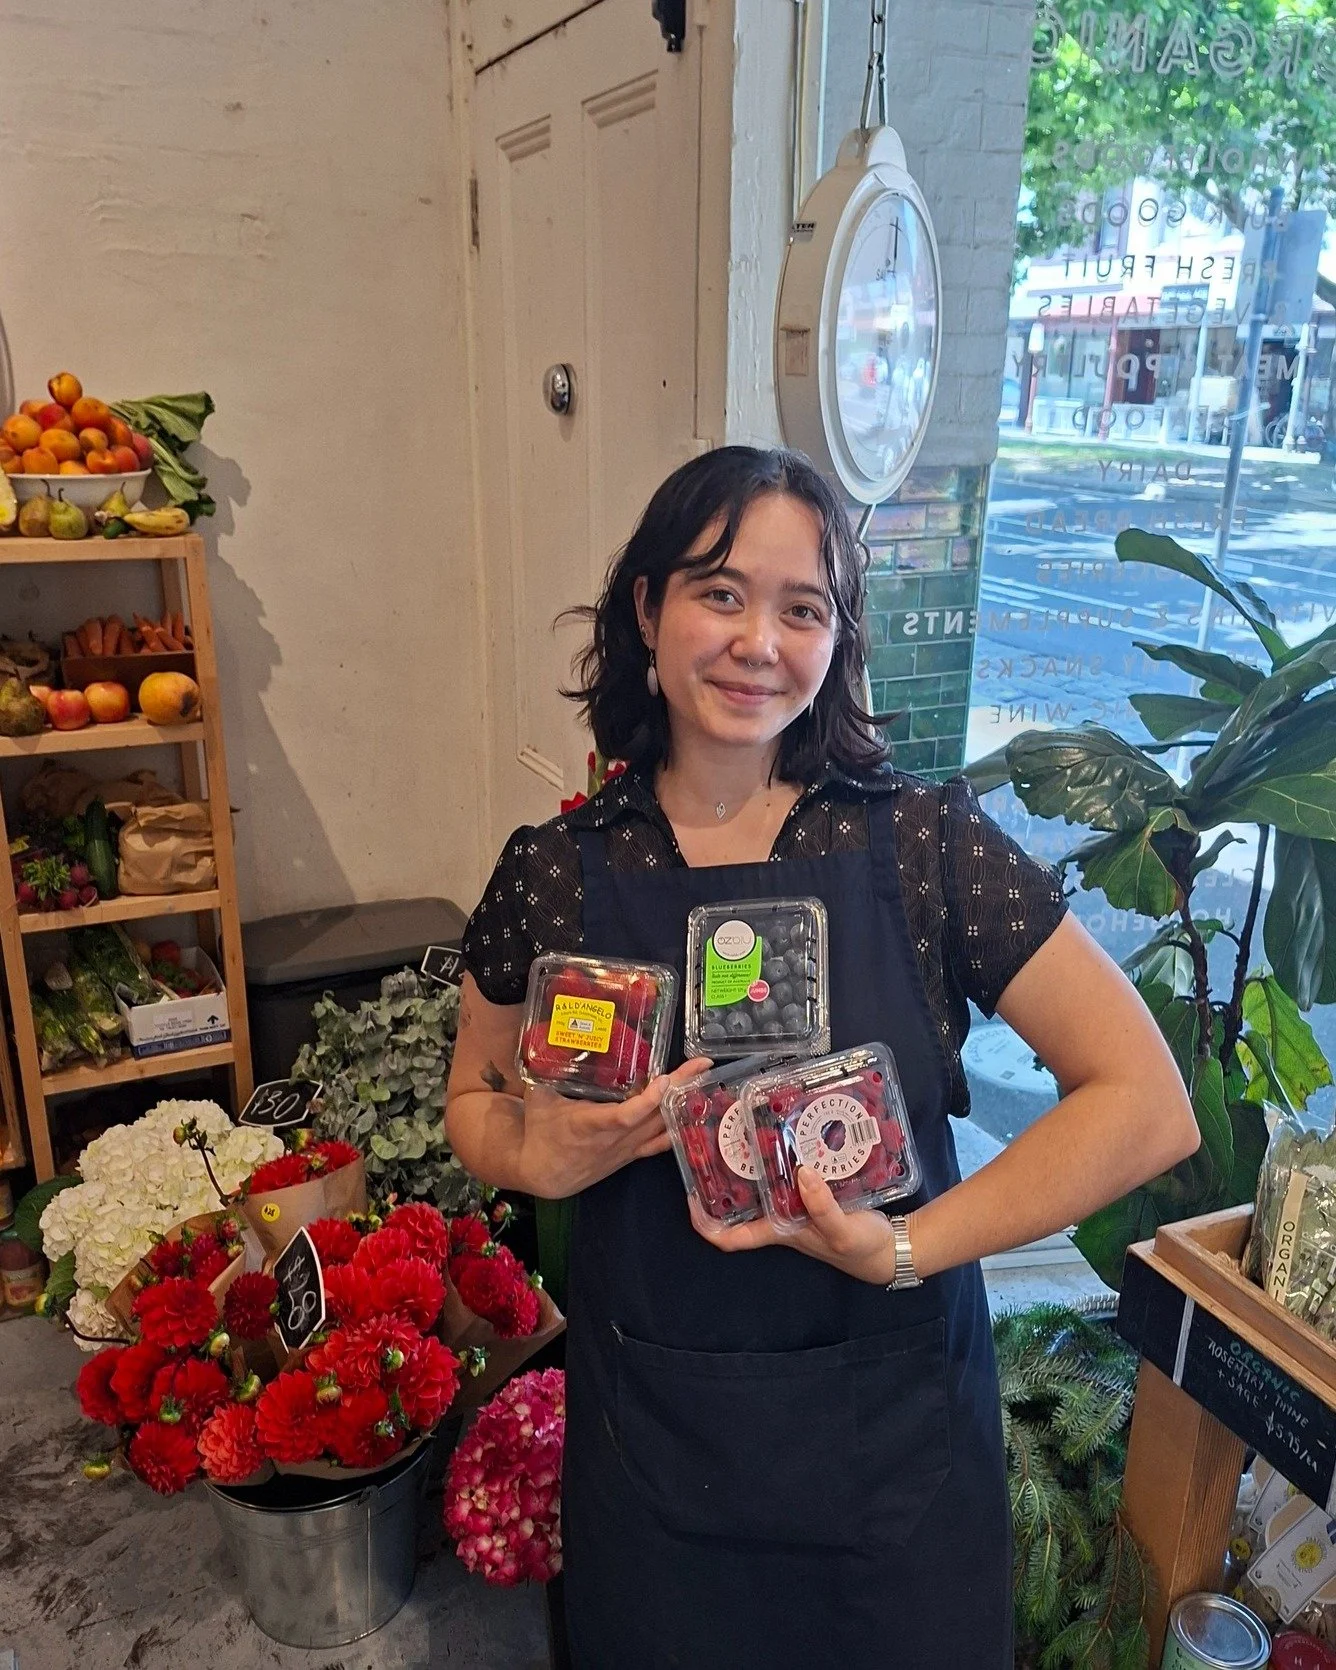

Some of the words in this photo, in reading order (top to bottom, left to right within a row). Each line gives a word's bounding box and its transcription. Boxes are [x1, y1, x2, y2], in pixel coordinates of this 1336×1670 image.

[555, 1003, 561, 1011] R
[555, 1036, 602, 1048] STRAWBERRIES
[586, 1034, 604, 1042] JUICY
[250, 1087, 300, 1120] $30
[800, 1099, 864, 1137] PERFECTION
[813, 1148, 866, 1174] BERRIES
[1229, 1340, 1301, 1402] ORGANIC
[1227, 1377, 1260, 1408] SAGE
[1274, 1394, 1310, 1429] THYME
